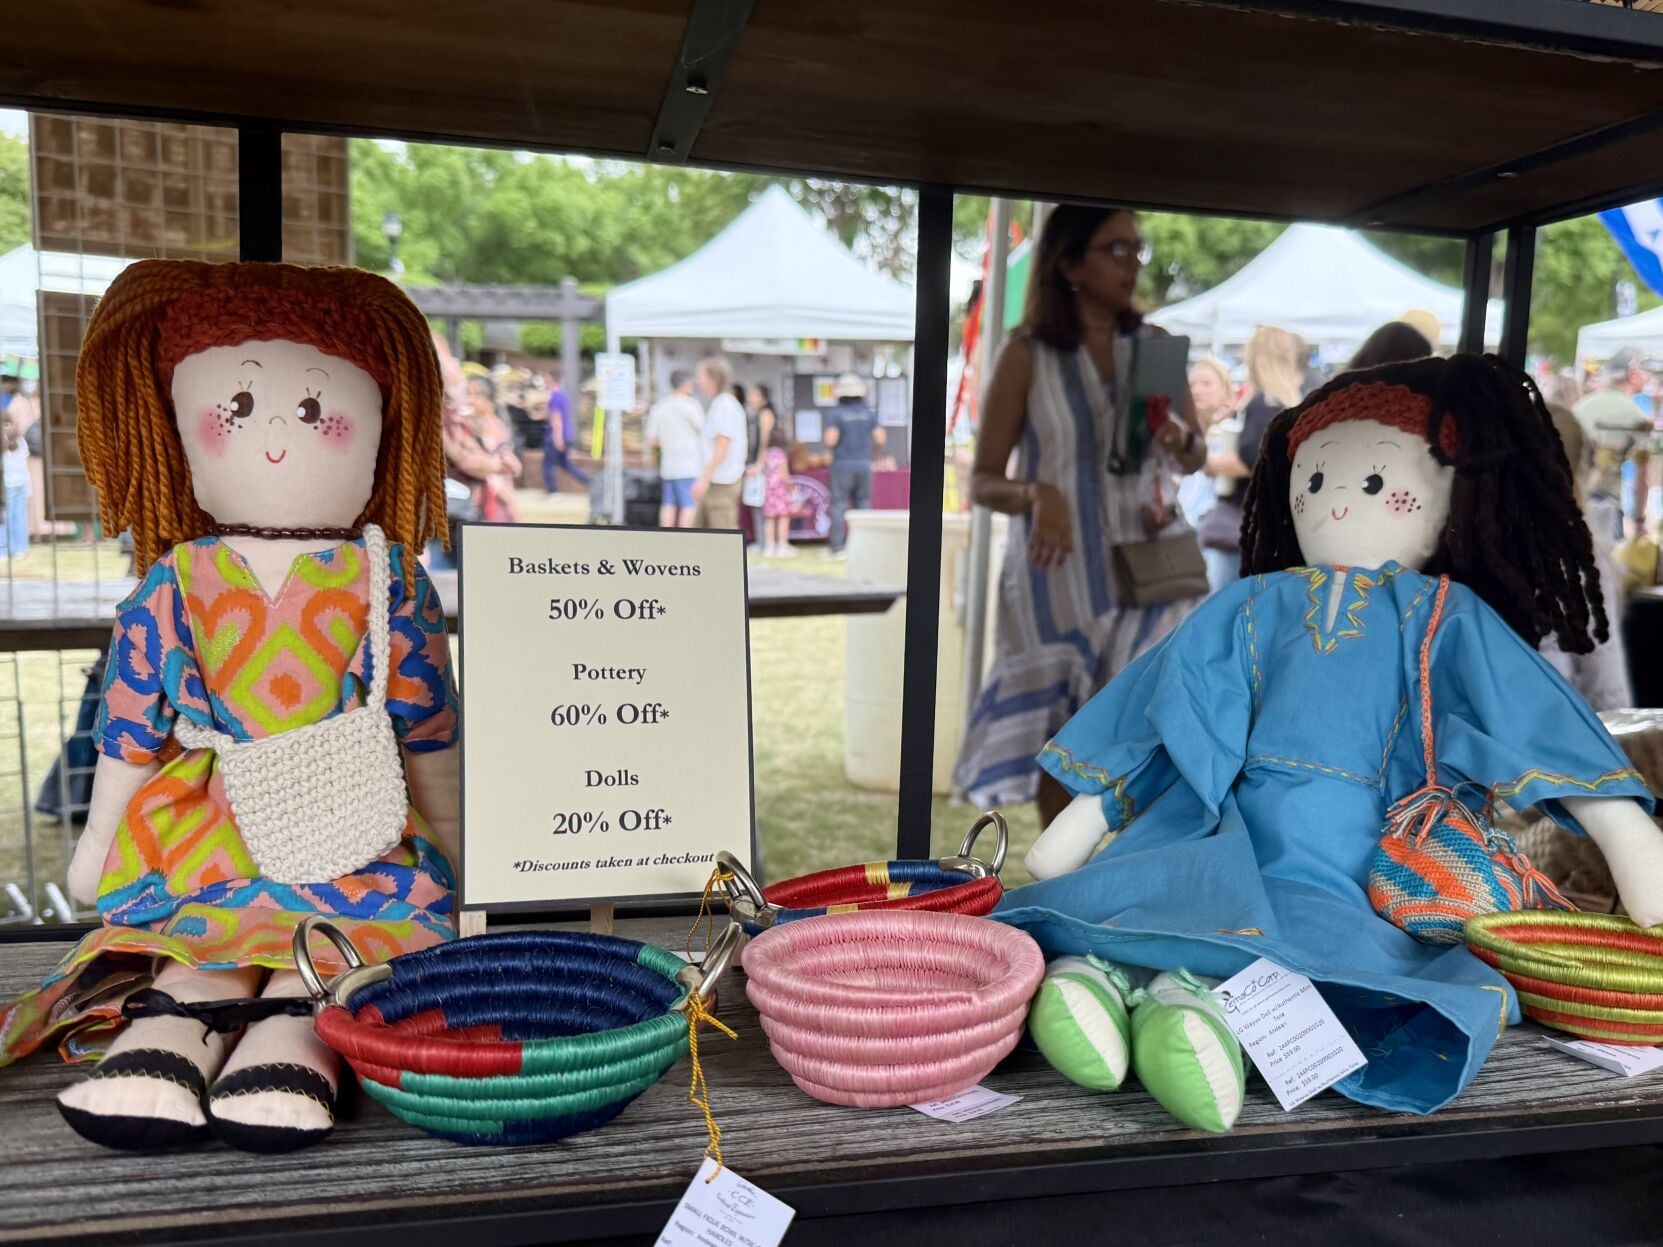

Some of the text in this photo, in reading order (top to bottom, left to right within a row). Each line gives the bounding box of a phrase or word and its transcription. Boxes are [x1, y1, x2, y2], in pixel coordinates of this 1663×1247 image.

[509, 558, 700, 576] Baskets & Wovens
[549, 599, 604, 619] 50%
[572, 664, 646, 684] Pottery
[551, 704, 606, 726] 60%
[585, 769, 638, 787] Dolls
[553, 811, 609, 834] 20%
[596, 857, 632, 868] taken
[637, 857, 650, 865] at
[653, 853, 714, 865] checkout
[1260, 1009, 1270, 1018] Doll
